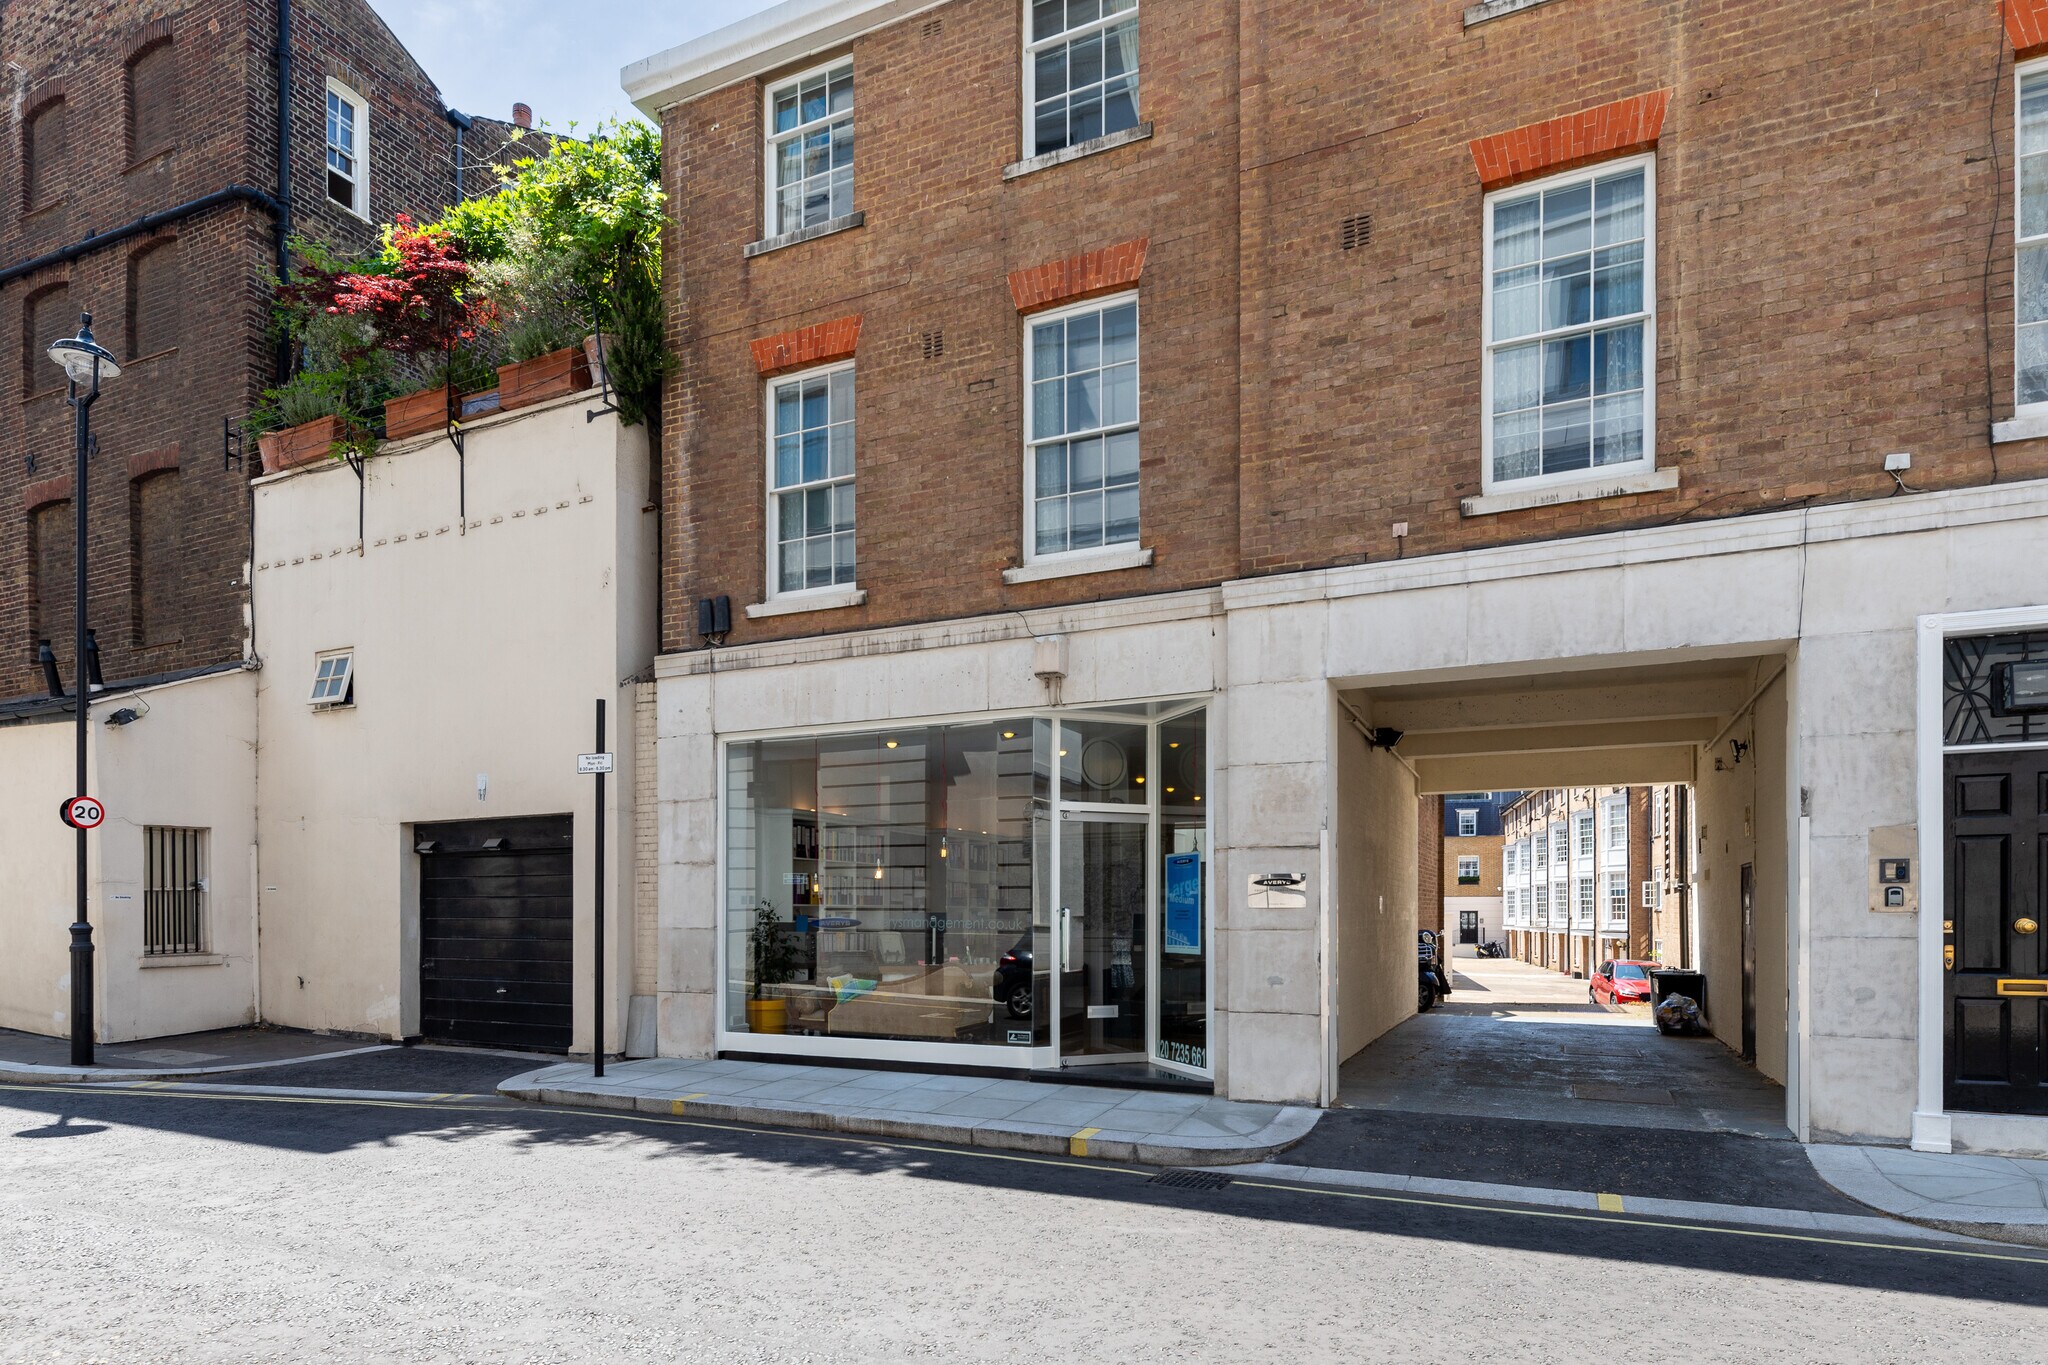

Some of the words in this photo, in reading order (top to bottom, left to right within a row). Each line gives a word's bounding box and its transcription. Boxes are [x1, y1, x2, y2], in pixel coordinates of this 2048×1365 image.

[74, 805, 100, 820] 20
[1169, 892, 1195, 905] Medium
[1156, 1039, 1169, 1059] 020
[1171, 1041, 1190, 1064] 7235
